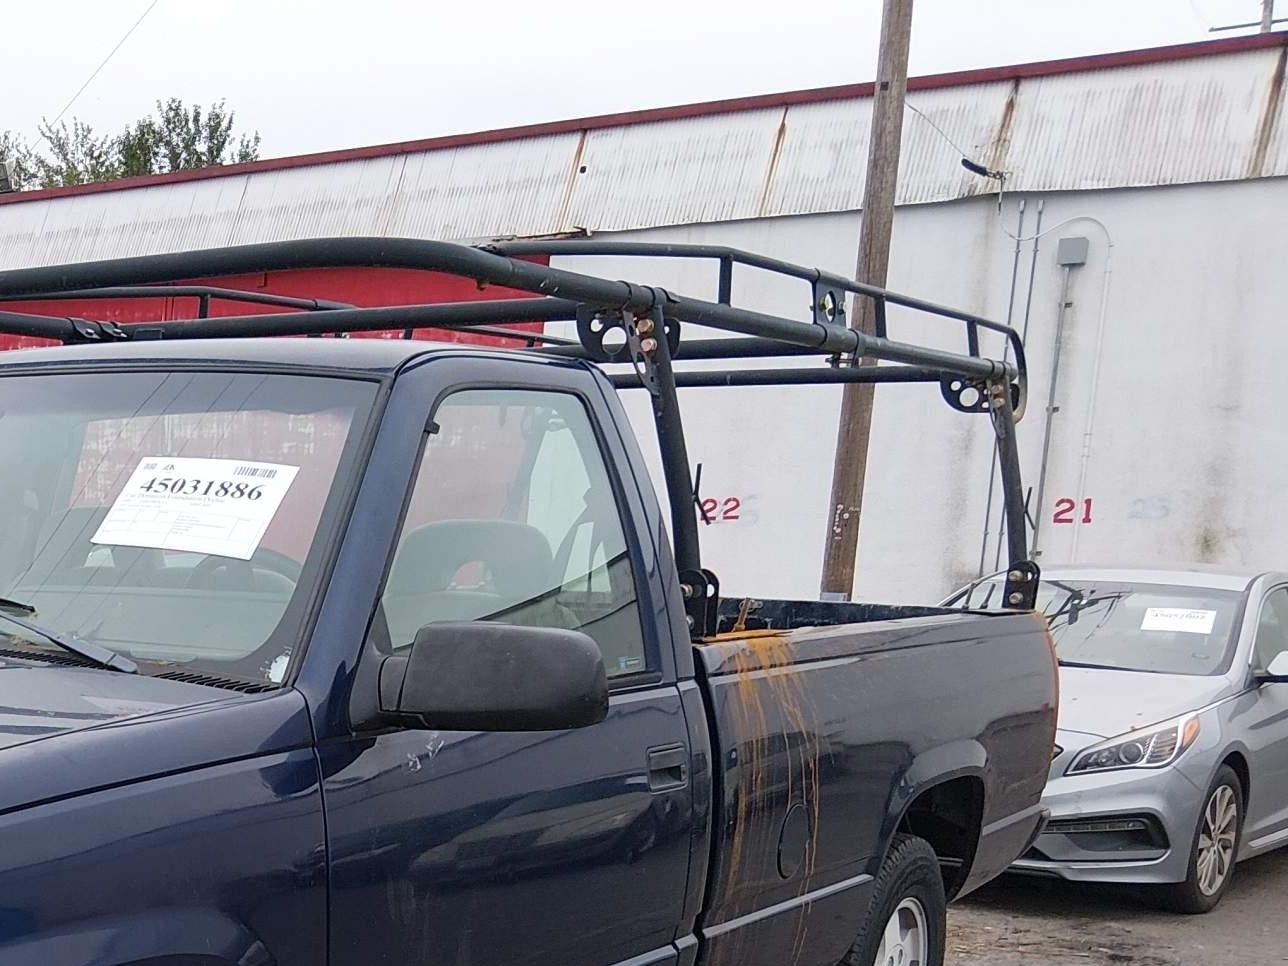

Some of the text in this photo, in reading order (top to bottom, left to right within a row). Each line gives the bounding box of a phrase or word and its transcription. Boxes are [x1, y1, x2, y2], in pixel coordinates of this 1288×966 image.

[140, 477, 266, 501] 45031886
[700, 497, 740, 521] 22
[1053, 498, 1092, 524] 21
